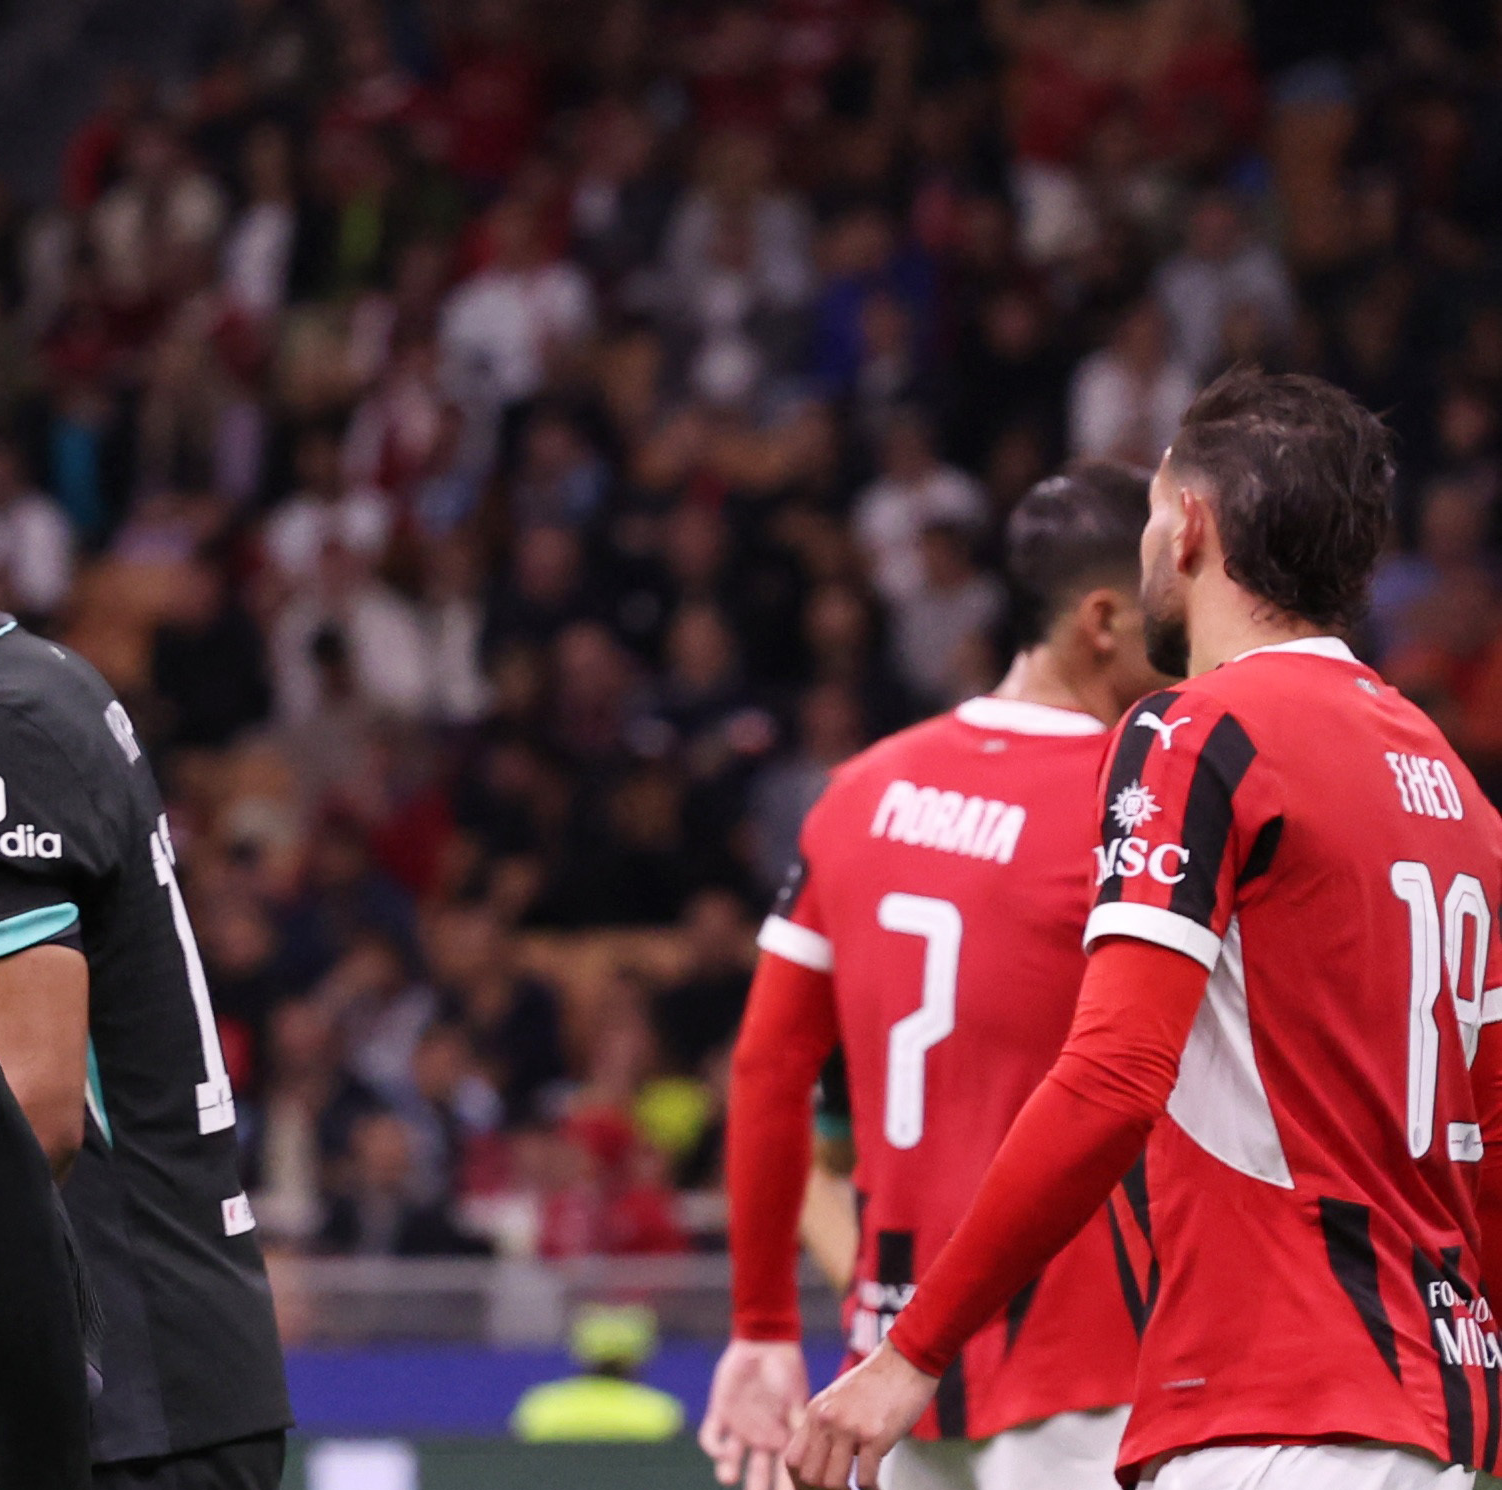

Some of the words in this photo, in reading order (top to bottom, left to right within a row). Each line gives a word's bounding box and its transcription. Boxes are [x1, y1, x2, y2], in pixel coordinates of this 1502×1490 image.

[869, 779, 1027, 865] MORATA
[1385, 751, 1463, 820] THEO
[1092, 836, 1190, 887] MSC
[877, 892, 963, 1151] 7
[1390, 860, 1491, 1161] 19
